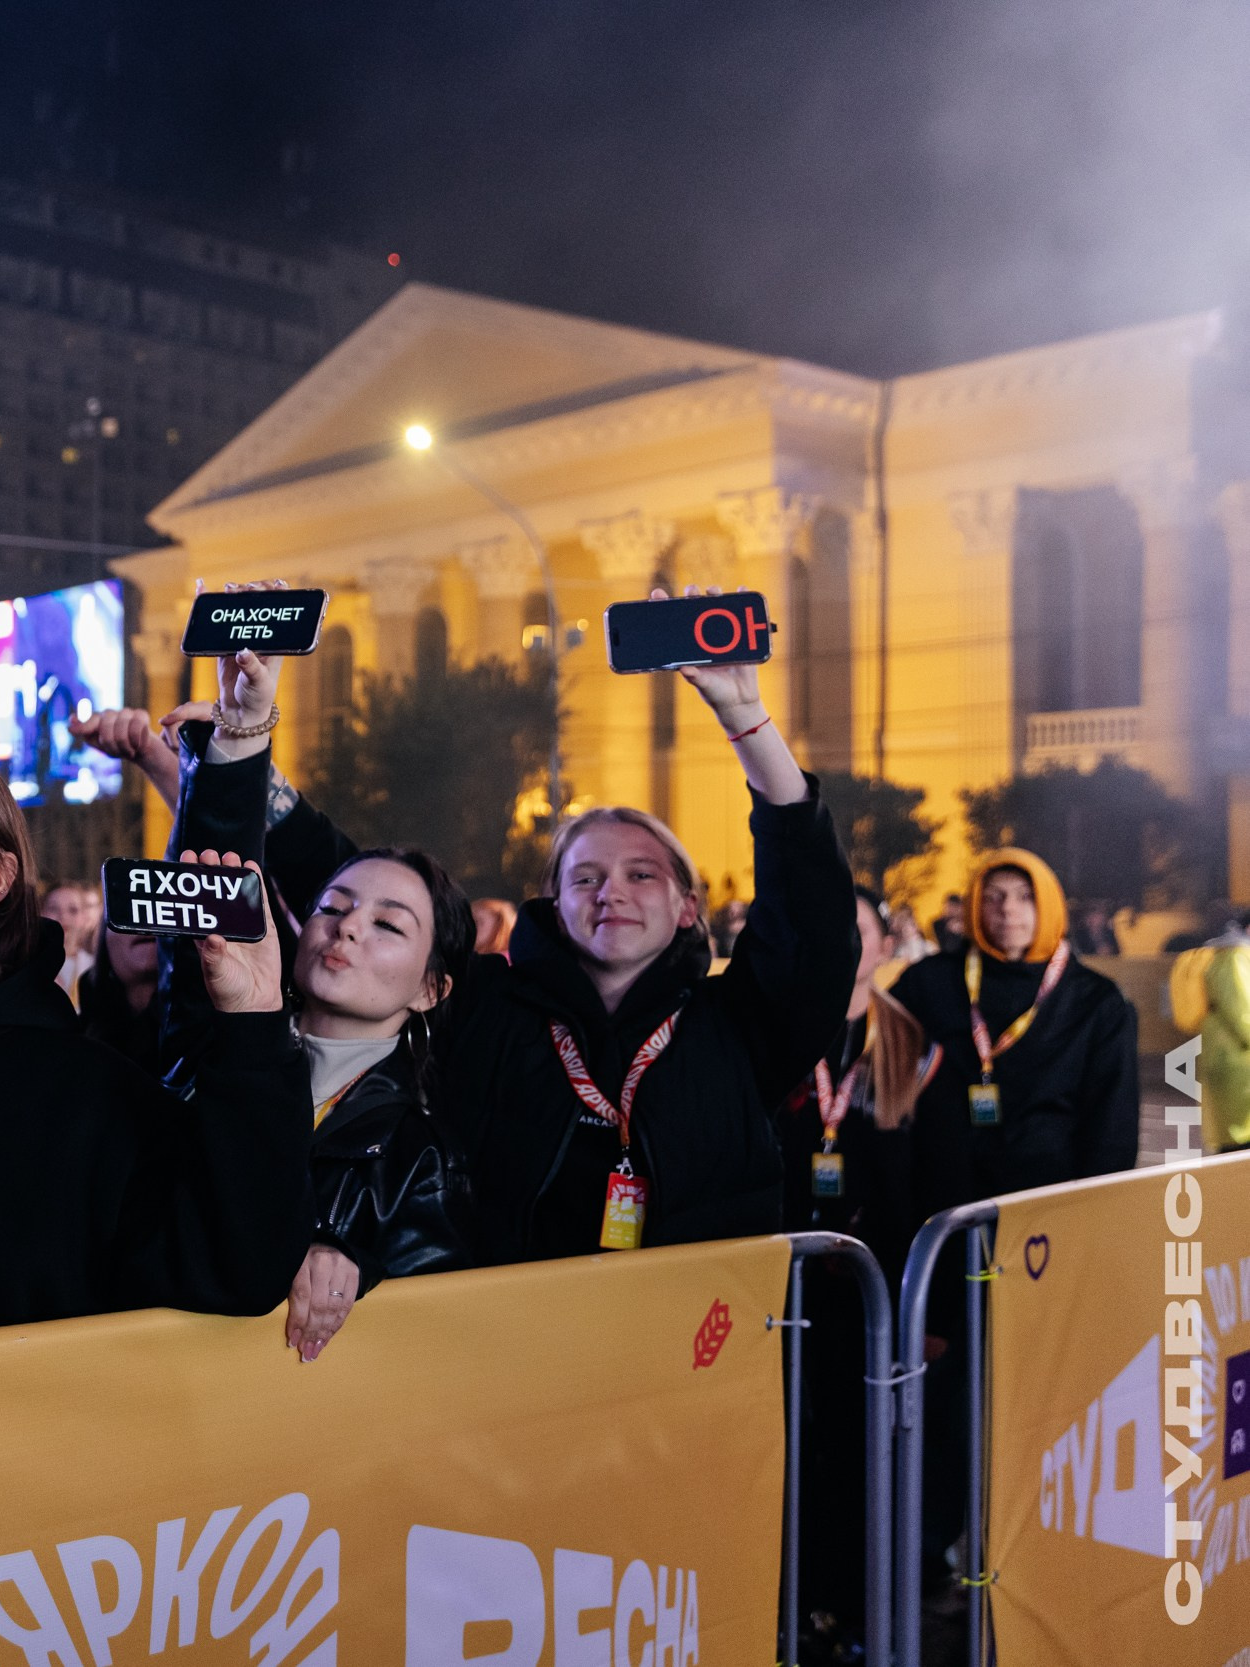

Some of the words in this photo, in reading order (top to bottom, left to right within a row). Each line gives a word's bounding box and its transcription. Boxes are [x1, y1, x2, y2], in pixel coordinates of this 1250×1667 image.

[211, 609, 246, 623] ОНА
[248, 607, 305, 622] ХОЧЕТ
[229, 625, 274, 640] ПЕТЬ
[128, 868, 151, 893] Я
[154, 870, 243, 901] ХОЧУ
[131, 899, 219, 929] ПЕТЬ
[1040, 1333, 1174, 1559] СТУД
